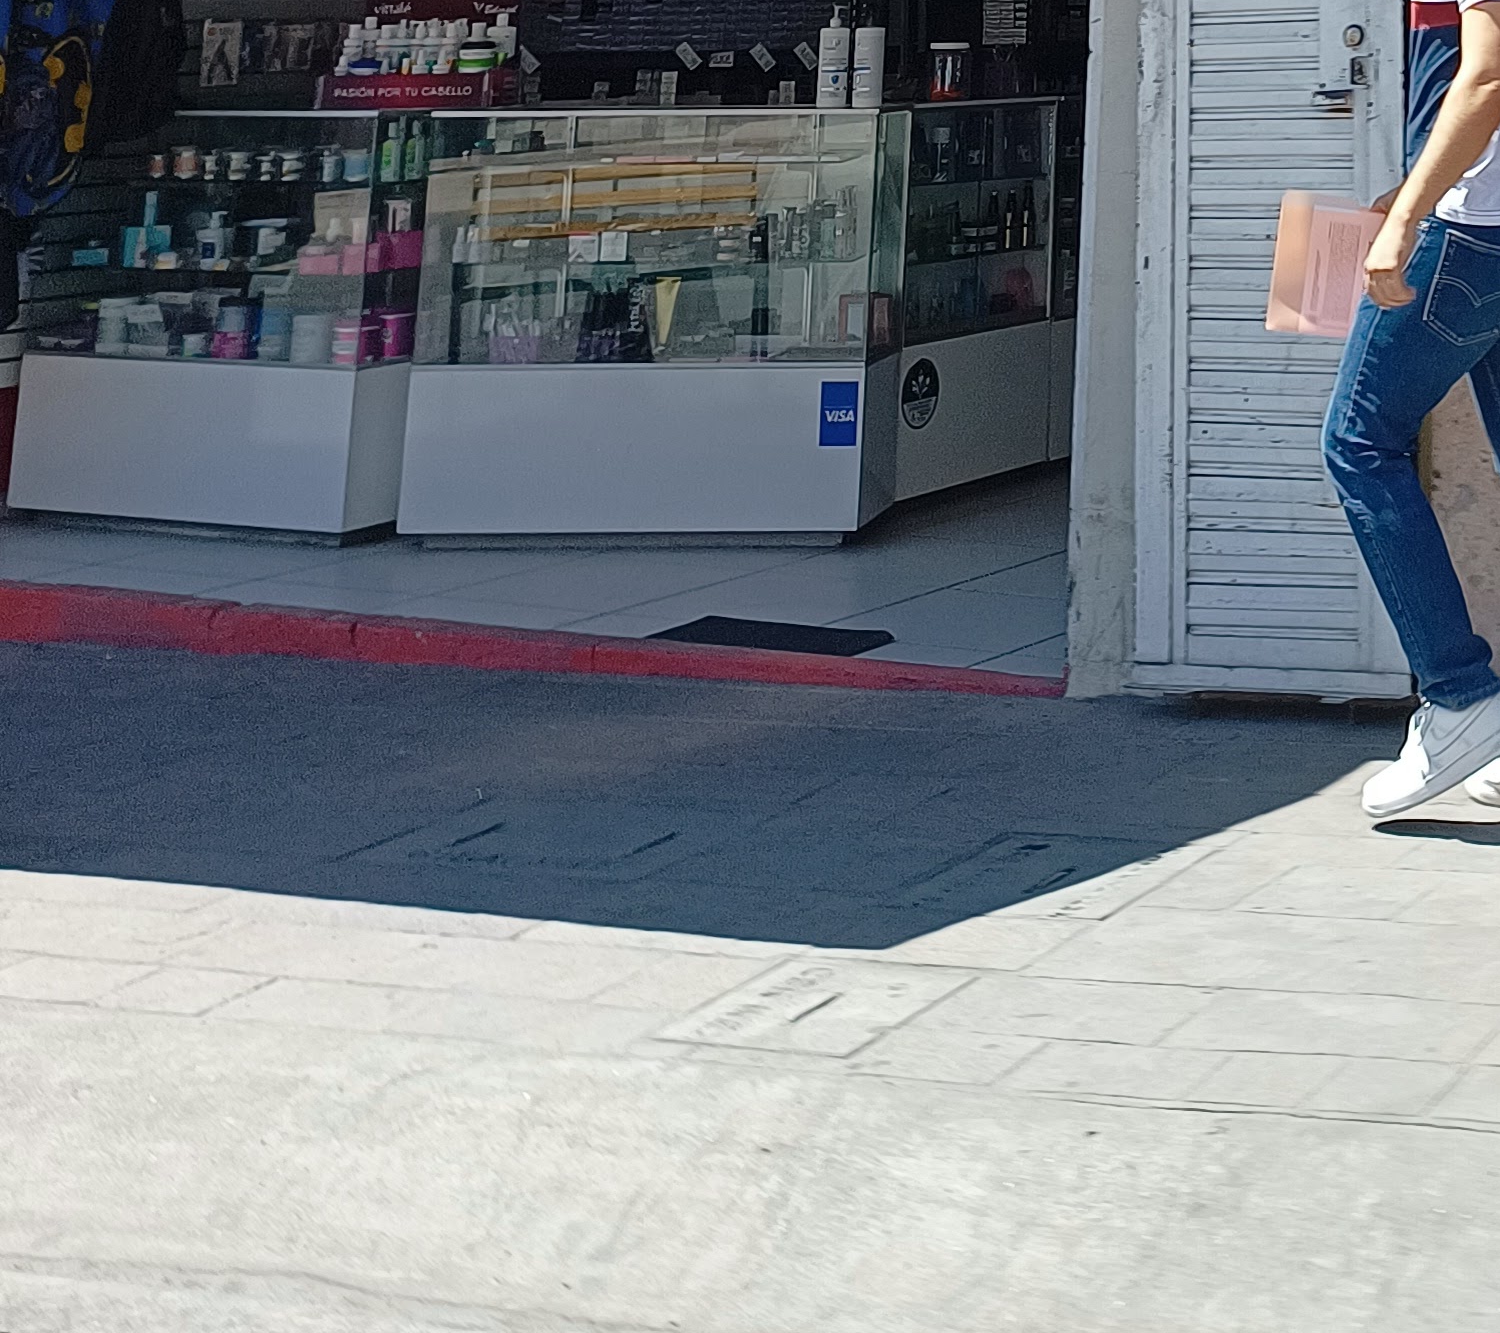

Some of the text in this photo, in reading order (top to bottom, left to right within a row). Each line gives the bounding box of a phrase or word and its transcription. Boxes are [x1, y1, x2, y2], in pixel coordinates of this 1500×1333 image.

[405, 87, 418, 97] TU
[420, 85, 473, 97] CABELLO
[824, 409, 855, 423] VISA
